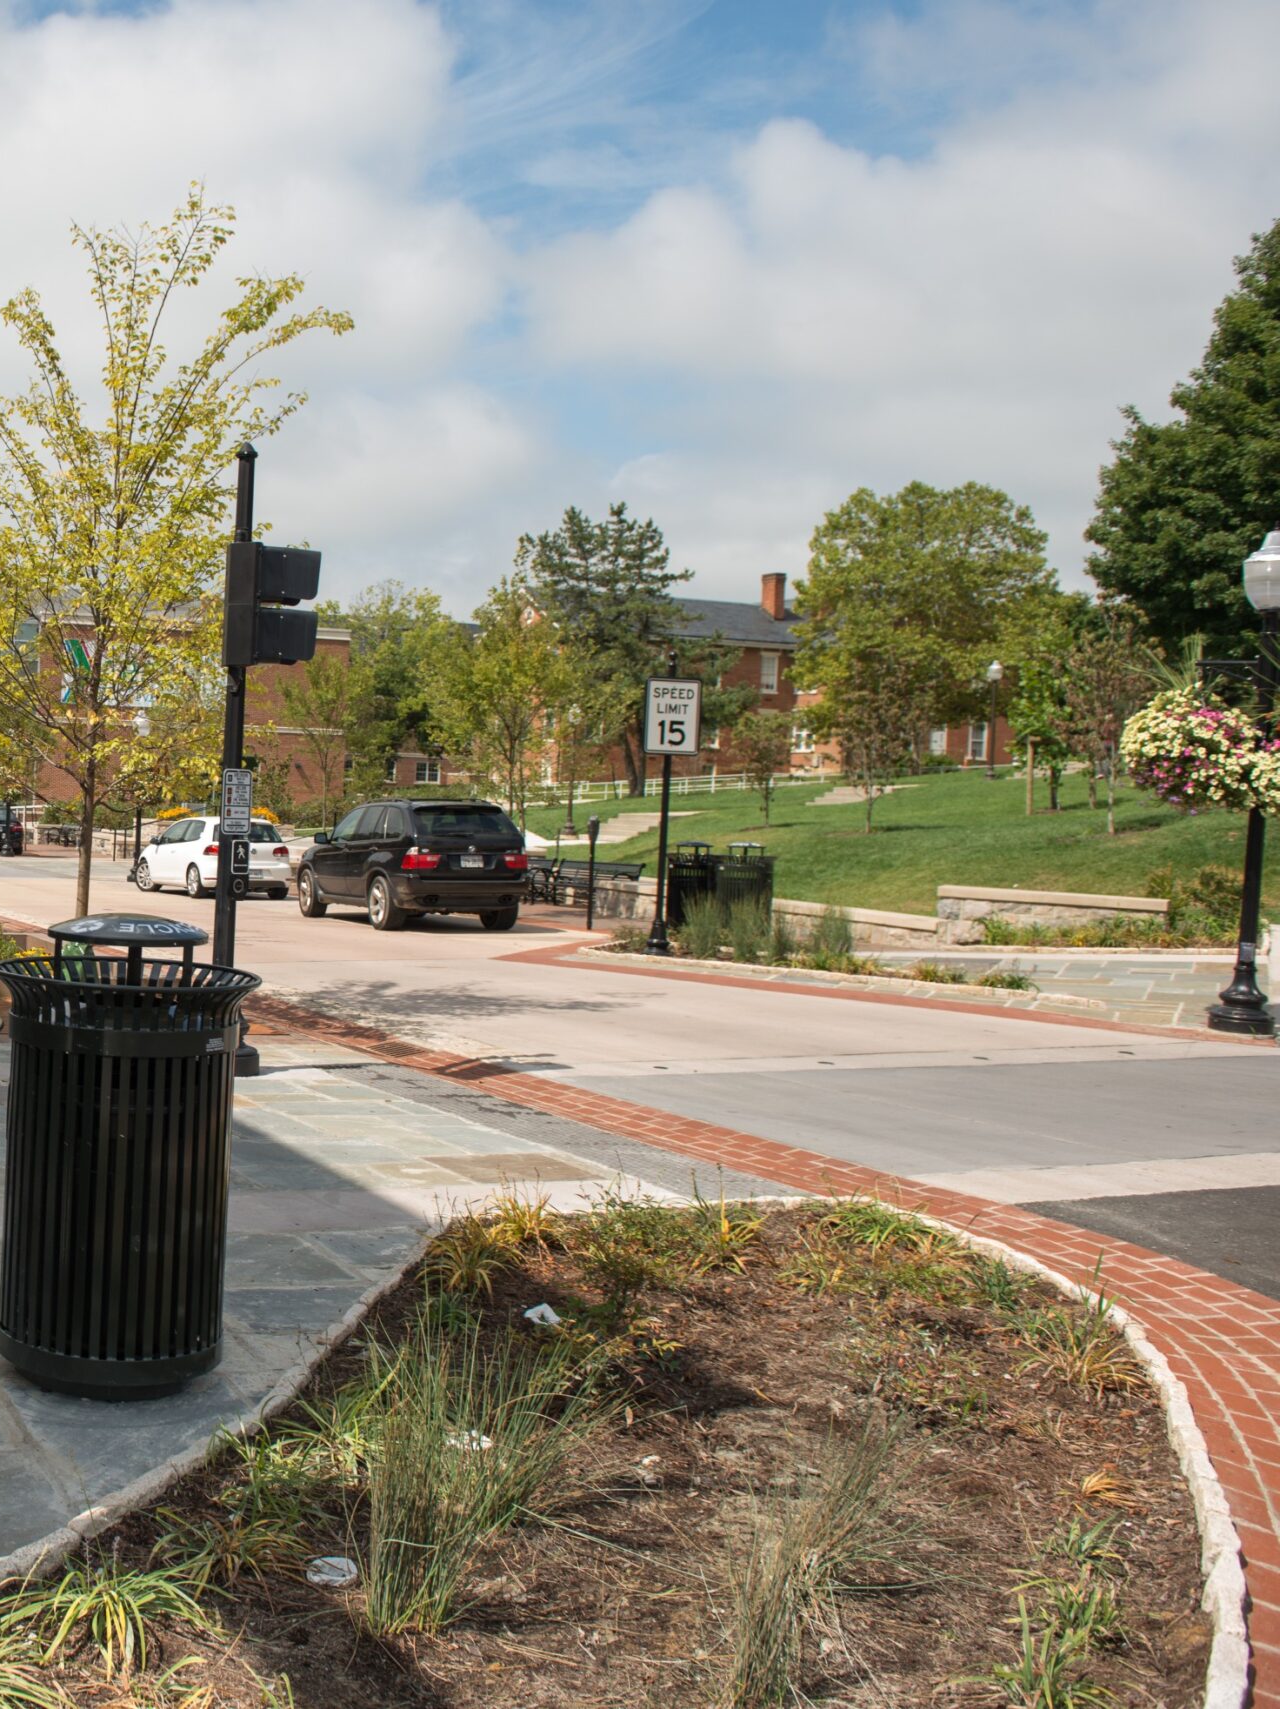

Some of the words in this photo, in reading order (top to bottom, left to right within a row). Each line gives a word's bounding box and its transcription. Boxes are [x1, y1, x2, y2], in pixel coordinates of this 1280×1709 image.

[653, 687, 694, 699] SPEED
[657, 703, 688, 714] LIMIT
[658, 720, 686, 746] 15
